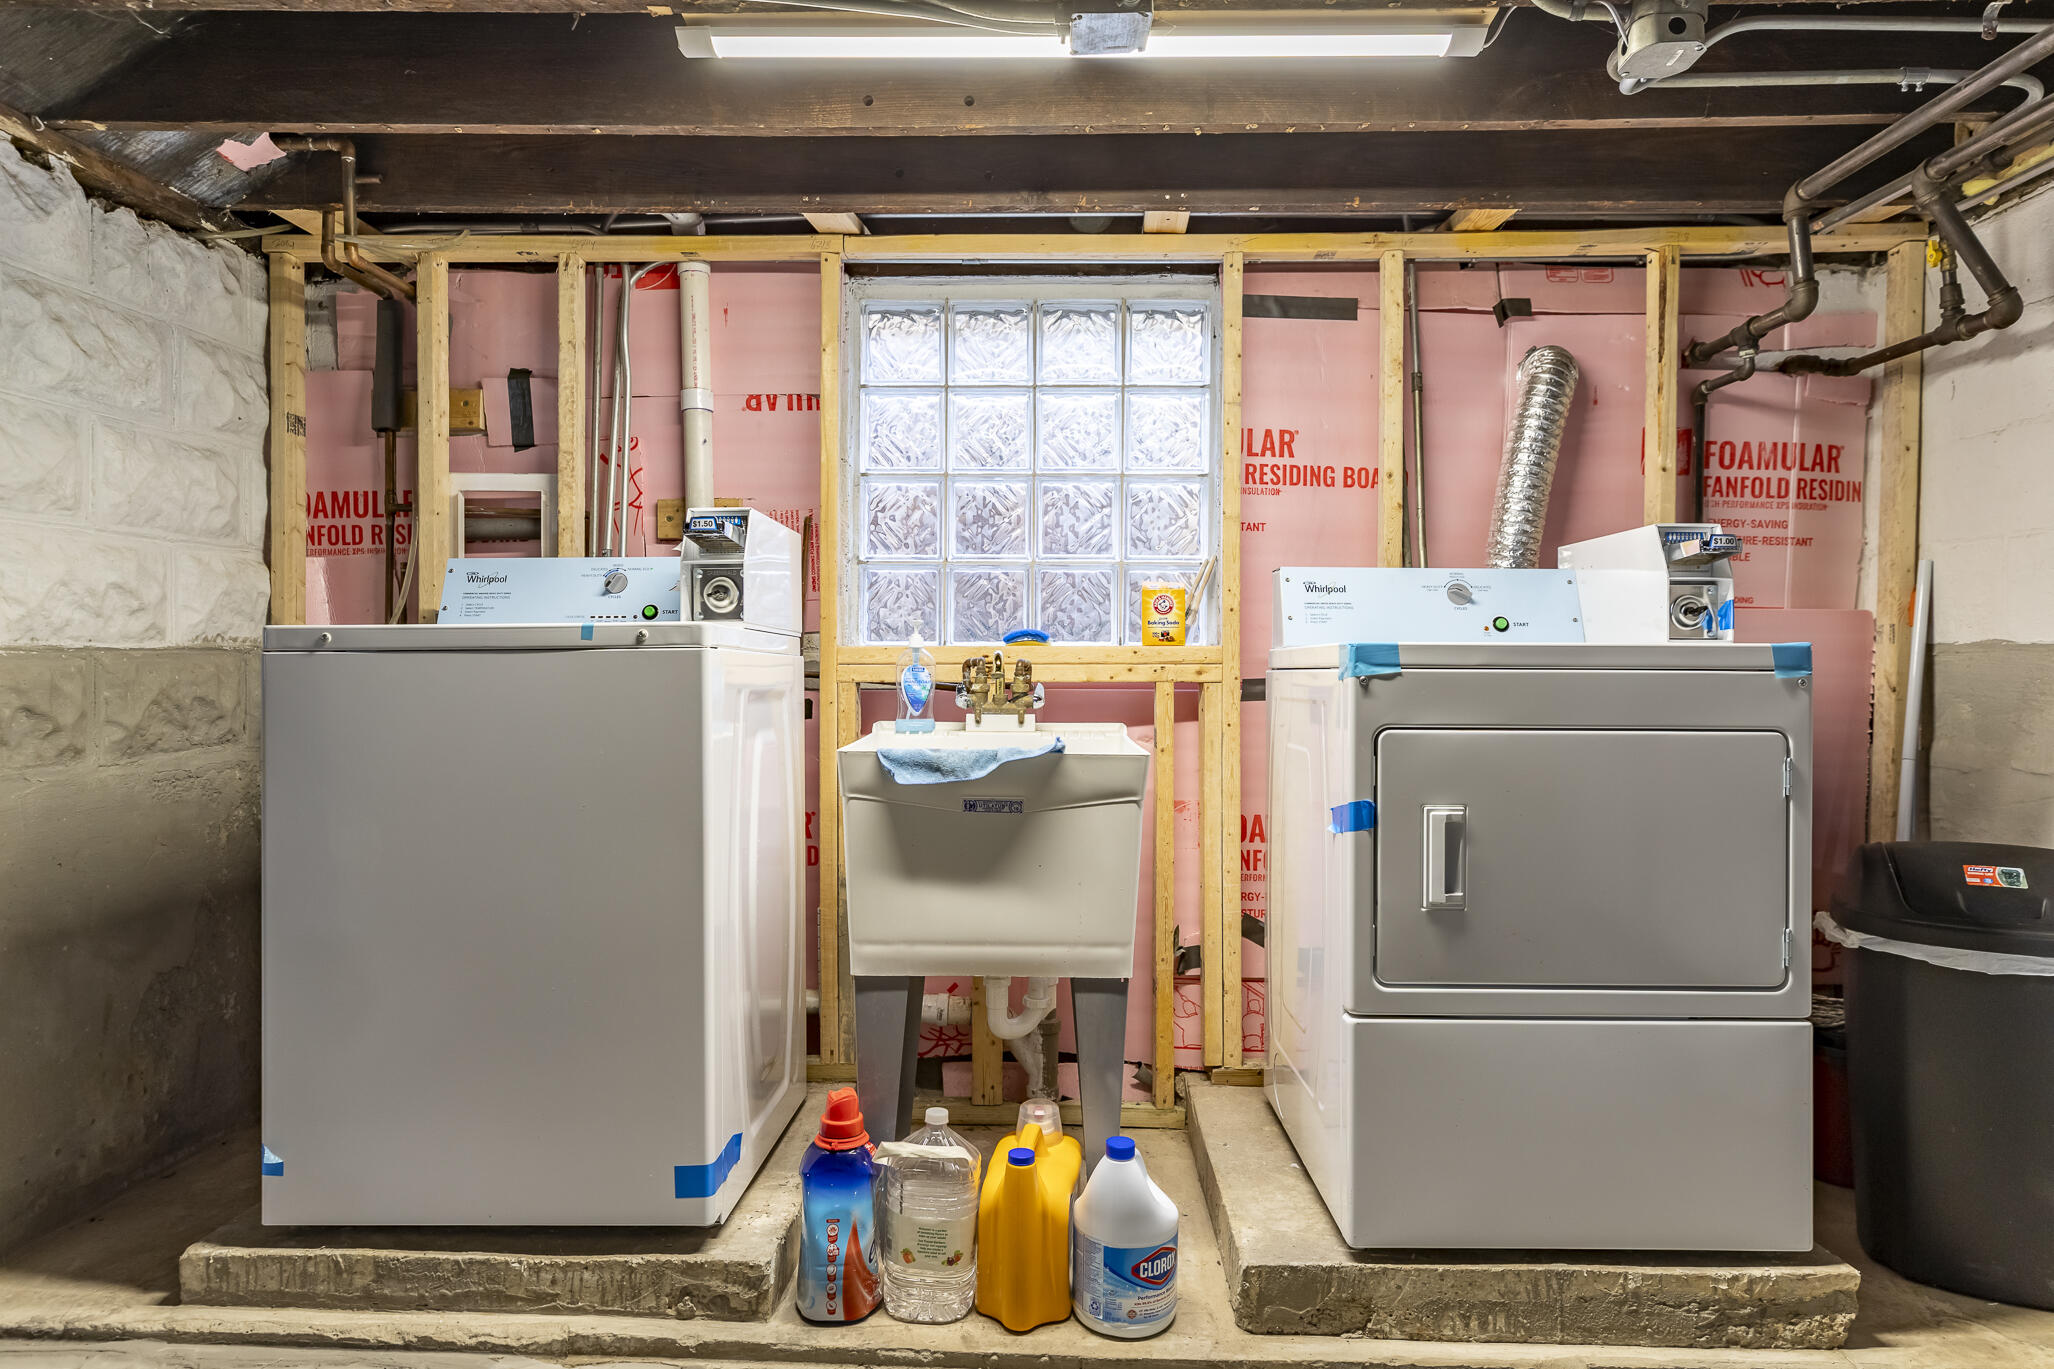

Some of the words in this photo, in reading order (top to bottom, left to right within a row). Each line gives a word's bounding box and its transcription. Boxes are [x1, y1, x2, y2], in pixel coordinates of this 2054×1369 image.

[1704, 440, 1841, 474] FOAMULAR
[1245, 463, 1336, 488] RESIDING
[1240, 487, 1281, 496] INSULATION
[1703, 476, 1790, 500] FANFOLD
[1797, 478, 1863, 502] RESIDIN
[1722, 500, 1774, 510] PERFORMANCE
[692, 520, 714, 528] $1.50
[371, 523, 413, 546] RSI
[1713, 537, 1735, 545] $1.00
[466, 575, 508, 585] Whirlpool
[1304, 584, 1347, 595] Whirlpool
[1240, 850, 1265, 871] NF
[1139, 1250, 1176, 1278] CLOROX
